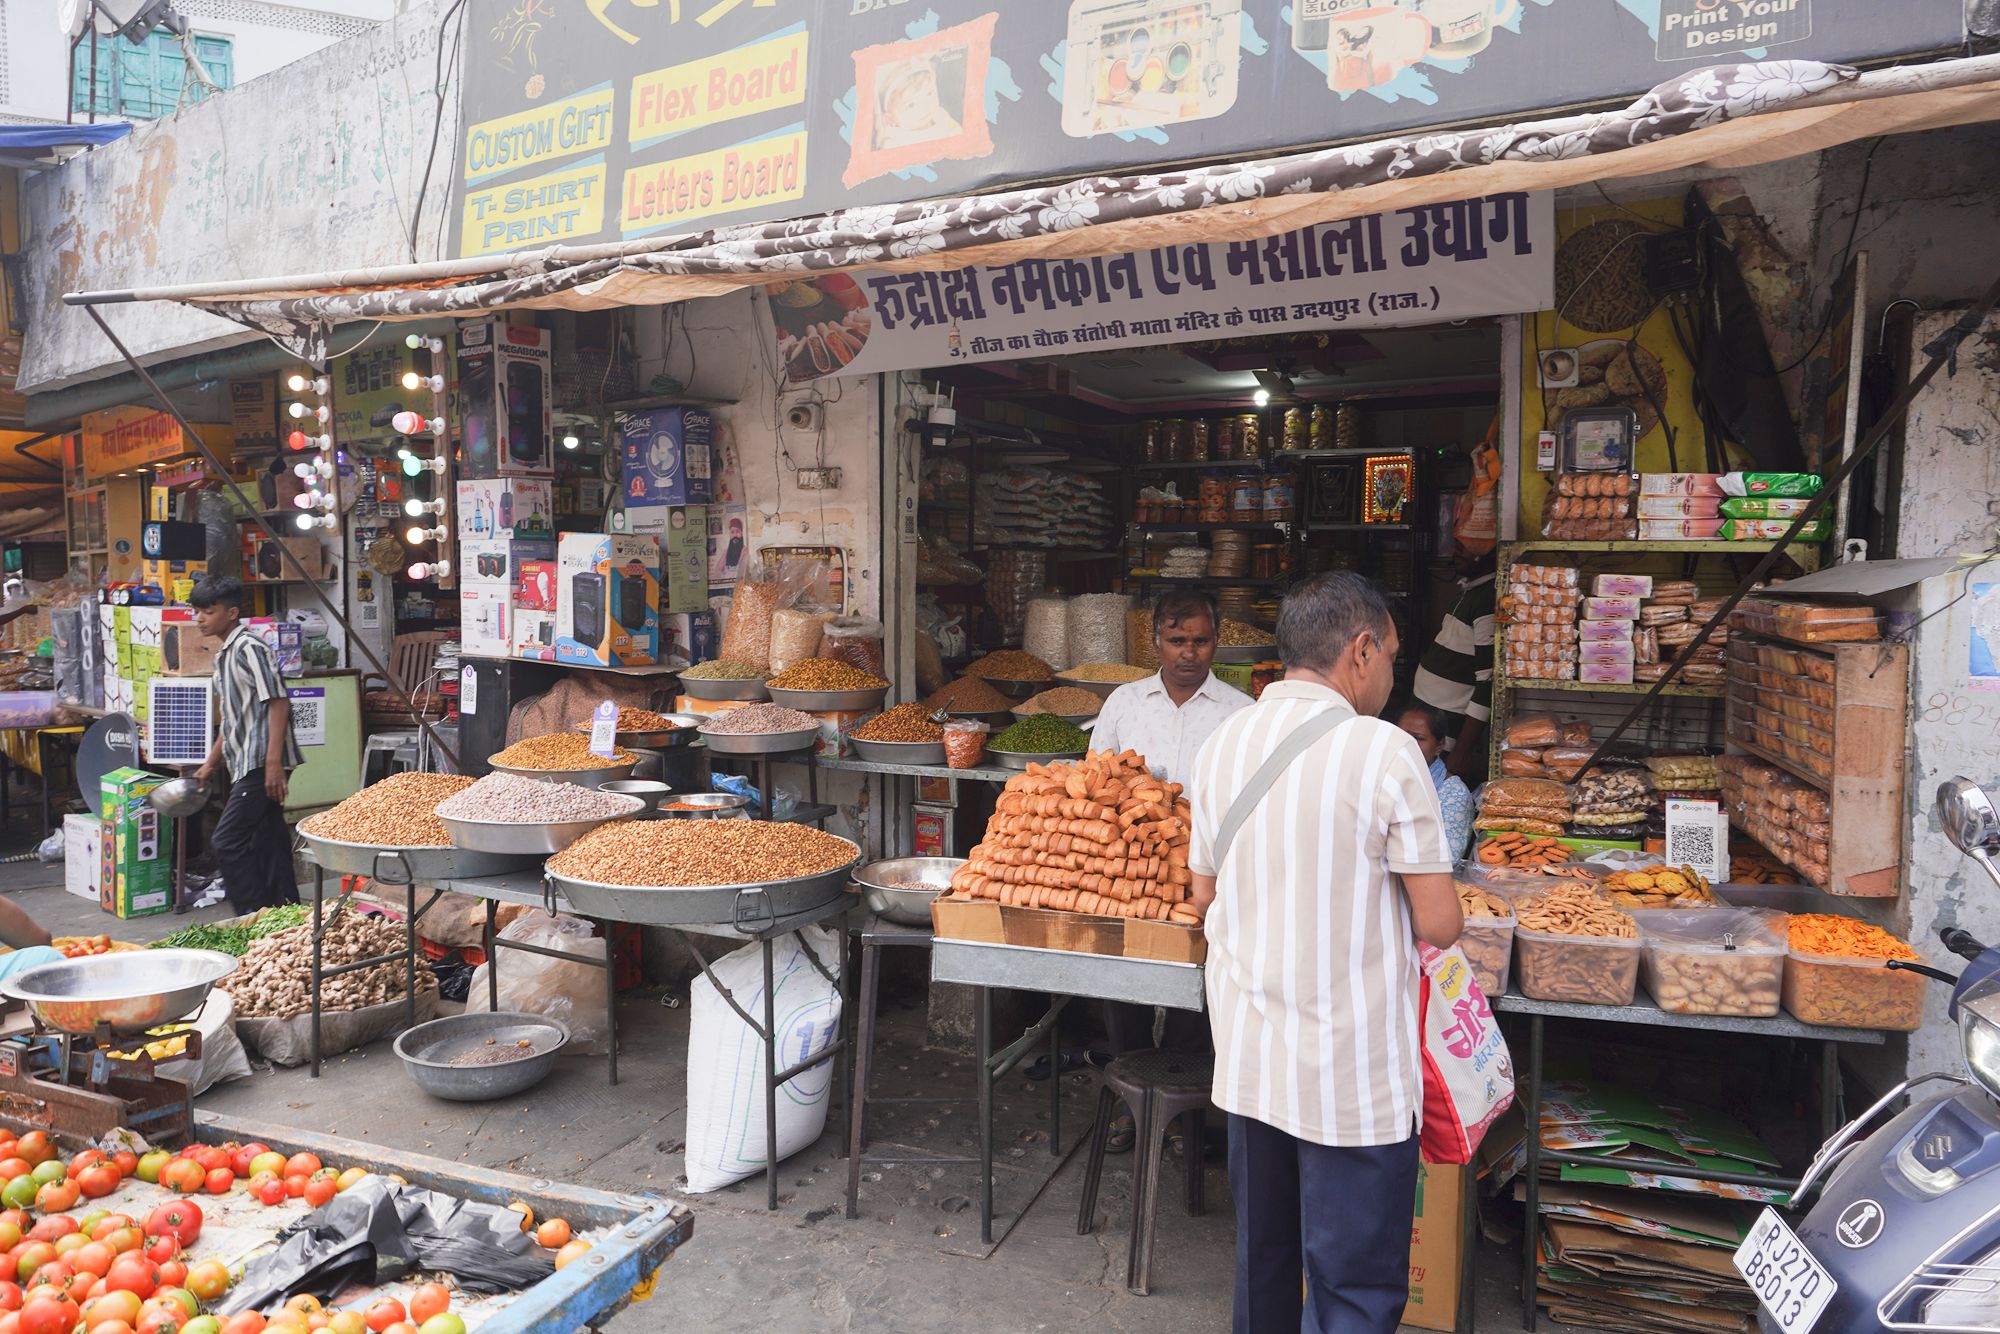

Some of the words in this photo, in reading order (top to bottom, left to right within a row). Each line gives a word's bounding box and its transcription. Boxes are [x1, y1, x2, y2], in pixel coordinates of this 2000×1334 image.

[1665, 7, 1728, 31] Print
[1737, 0, 1798, 18] Your
[1686, 19, 1778, 49] Design
[637, 82, 698, 129] Flex
[707, 48, 799, 112] Board
[469, 117, 553, 172] CUSTOM
[558, 101, 611, 148] GIFT
[627, 167, 714, 221] Letters
[722, 138, 800, 202] Board
[482, 209, 581, 249] PRINT
[970, 336, 1005, 355] तीज
[1006, 335, 1031, 350] का
[1033, 328, 1070, 347] चौक
[1072, 320, 1128, 343] संतोषी
[1130, 317, 1172, 337] माता
[1174, 311, 1221, 331] मंदिर
[1223, 306, 1244, 327] के
[1248, 304, 1288, 324] पास
[1291, 297, 1361, 322] उदयपुर
[498, 343, 549, 359] MEGABOOM
[683, 411, 711, 426] GRACE
[1839, 1221, 1863, 1245] ADVOCATE
[1763, 1223, 1820, 1299] RJ27D
[1745, 1250, 1801, 1327] B6013
